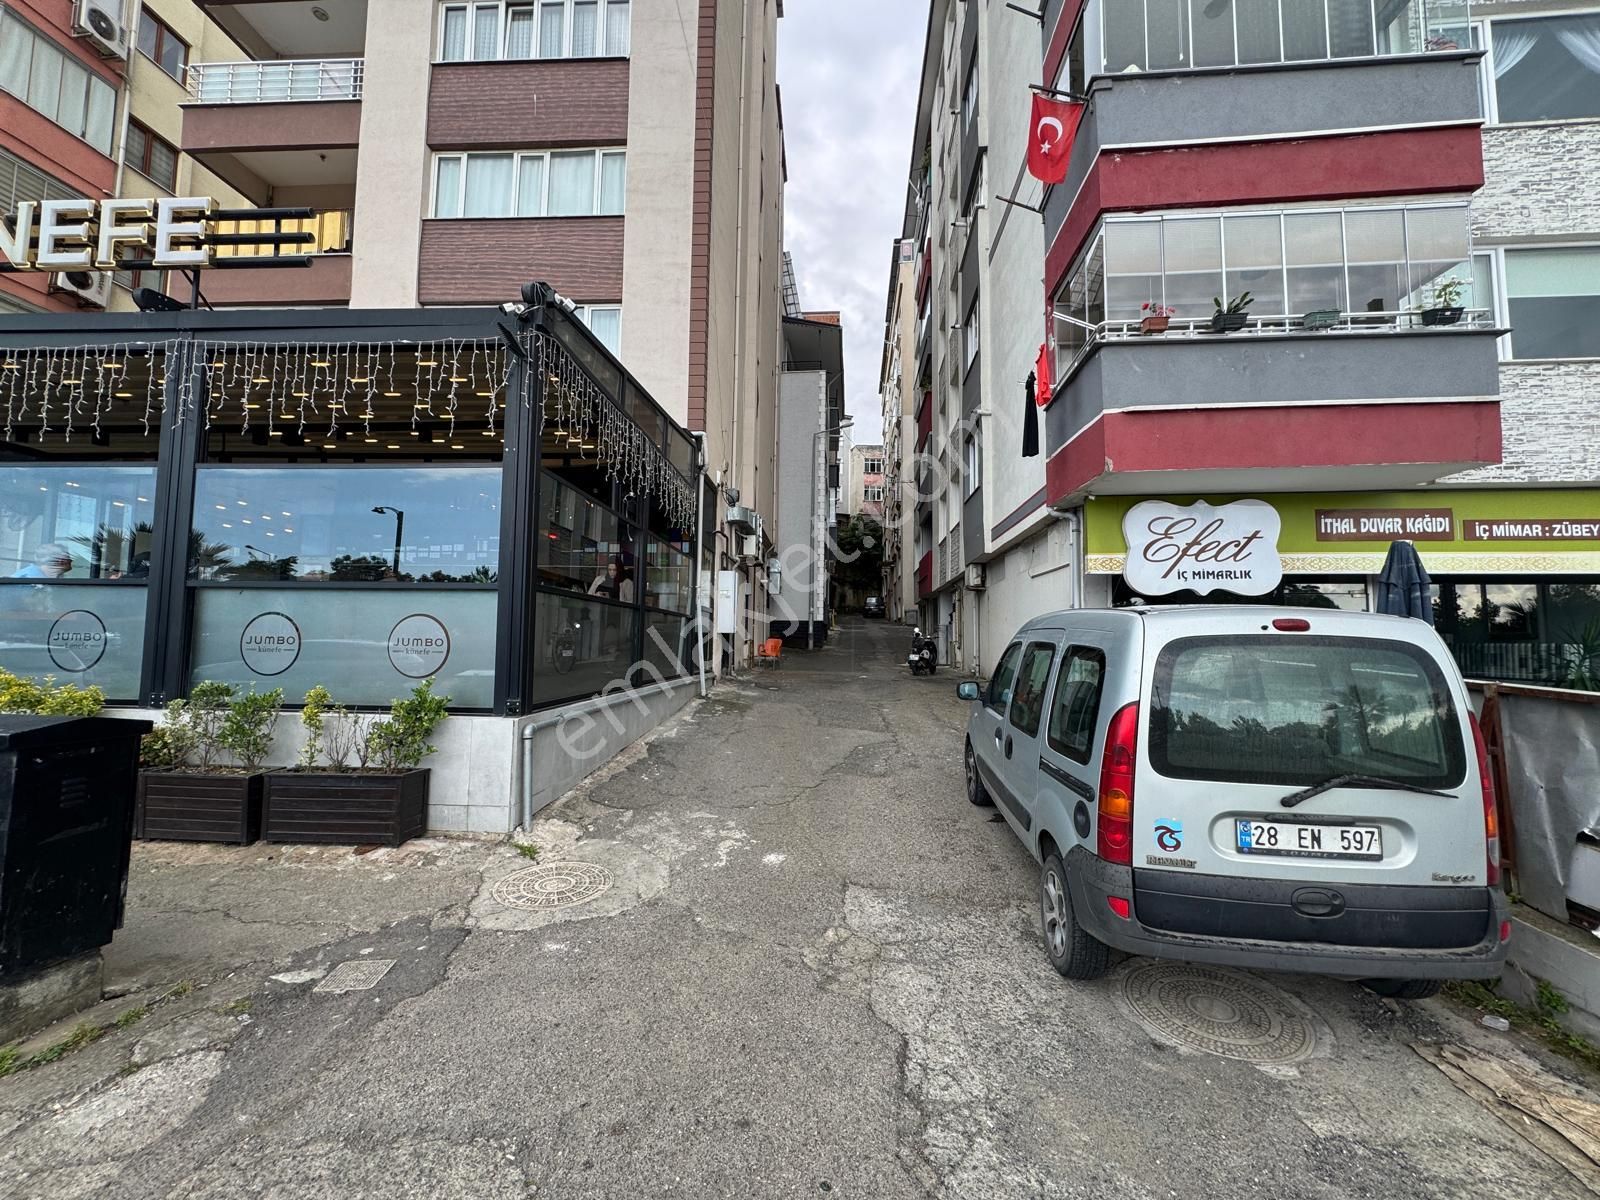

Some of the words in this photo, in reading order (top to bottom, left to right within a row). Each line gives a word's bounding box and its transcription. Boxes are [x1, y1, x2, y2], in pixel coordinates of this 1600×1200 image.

[1321, 515, 1357, 534] İTHAL
[1360, 517, 1402, 534] DUVAR
[1406, 514, 1450, 533] KAĞIDI
[1475, 521, 1490, 540] İÇ
[1492, 521, 1542, 537] MİMAR
[1551, 521, 1600, 537] ZÜBEY
[1142, 516, 1264, 579] Efect
[1177, 569, 1188, 582] İÇ
[1192, 569, 1252, 580] MİMARLIK
[53, 632, 102, 641] JUMBO
[245, 635, 296, 645] JUMBO
[393, 637, 444, 647] JUMBO
[1254, 825, 1278, 847] 28
[1298, 828, 1322, 850] EN
[1340, 829, 1375, 852] 597
